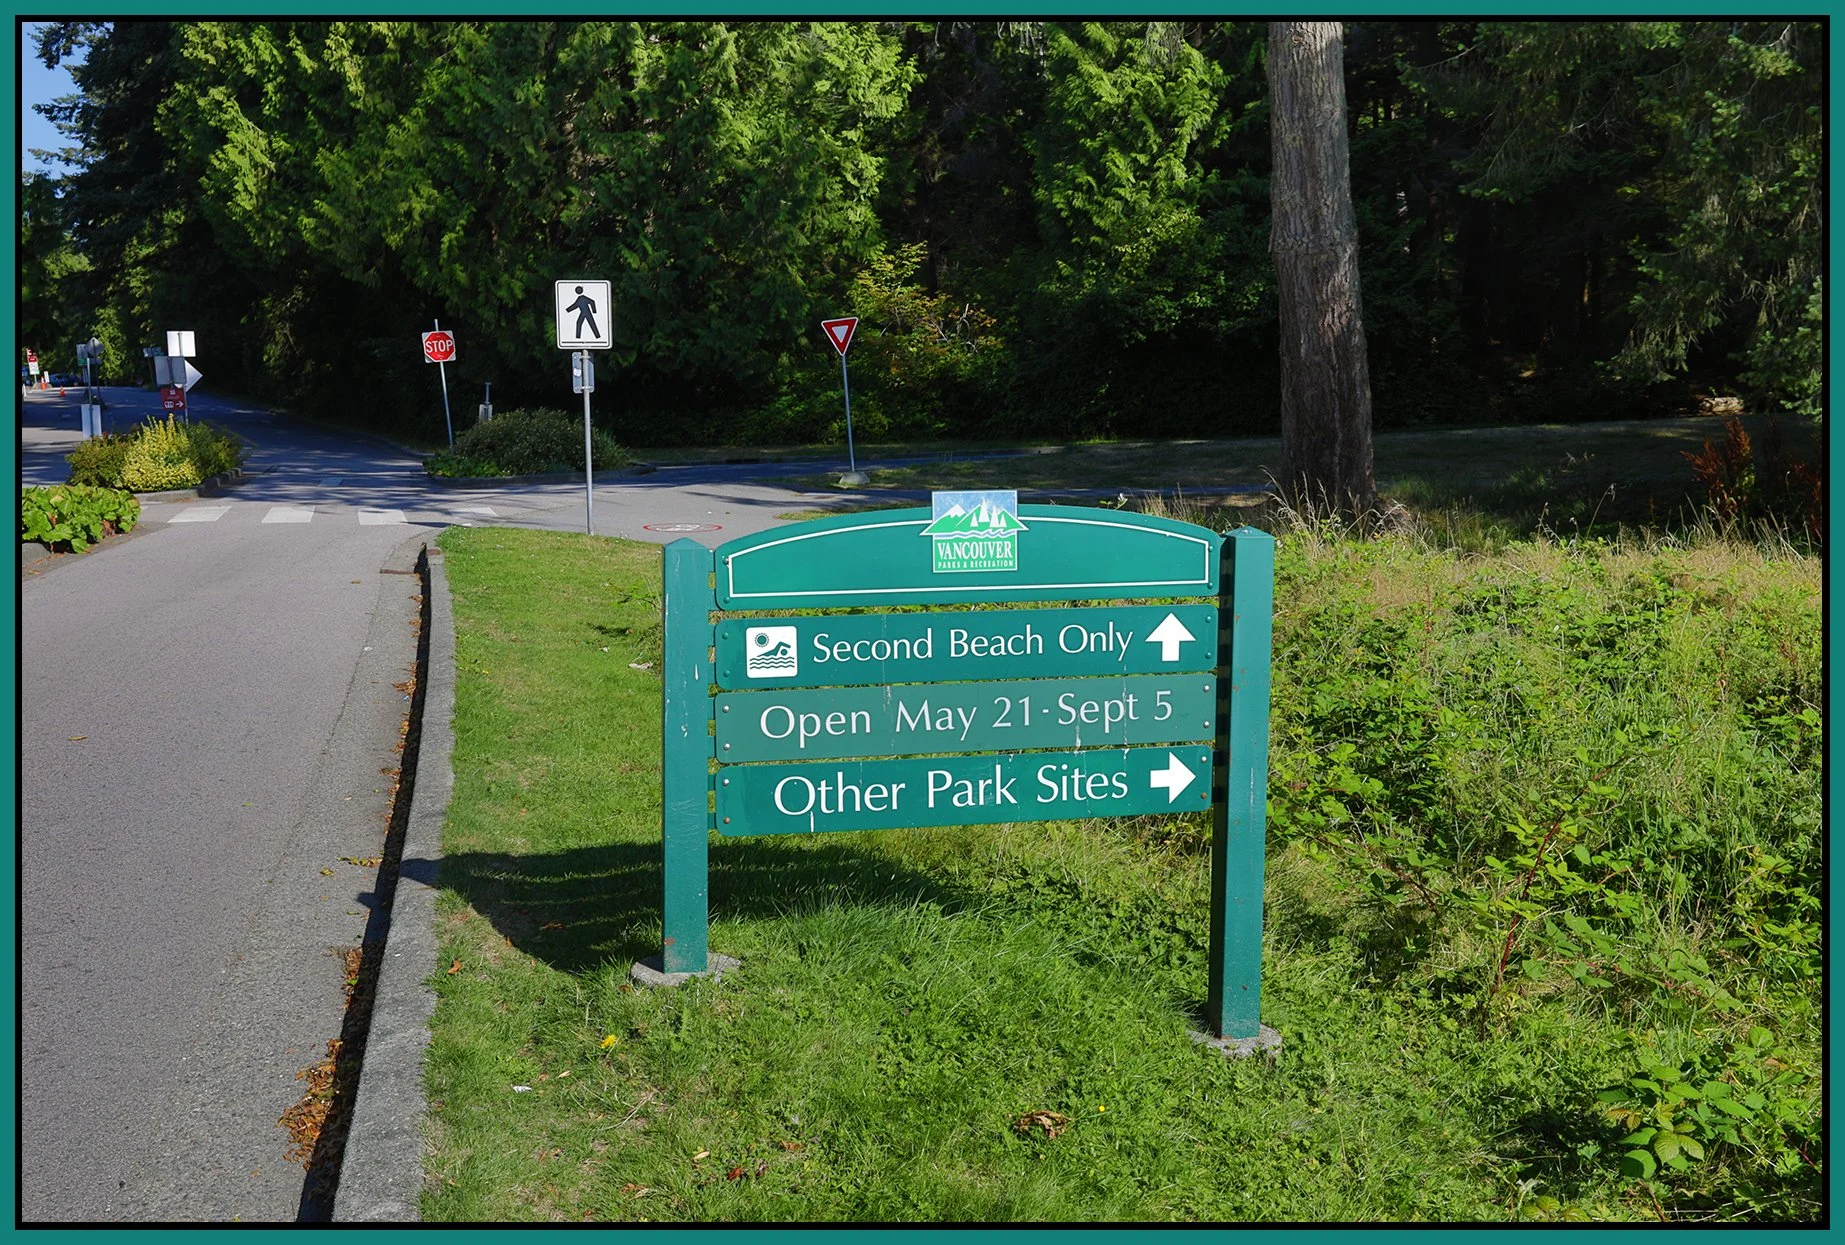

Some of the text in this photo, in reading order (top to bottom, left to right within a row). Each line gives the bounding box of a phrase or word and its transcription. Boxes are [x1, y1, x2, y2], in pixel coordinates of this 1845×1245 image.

[426, 339, 453, 353] STOP
[937, 540, 1013, 560] VANCOUVER
[938, 561, 961, 569] PARKS
[970, 559, 1014, 569] RECREATION
[813, 620, 1133, 664] Second Beach Only
[760, 704, 871, 748] Open
[895, 699, 978, 741] May
[1155, 689, 1173, 722] 5
[774, 764, 1128, 817] Other Park Sites
